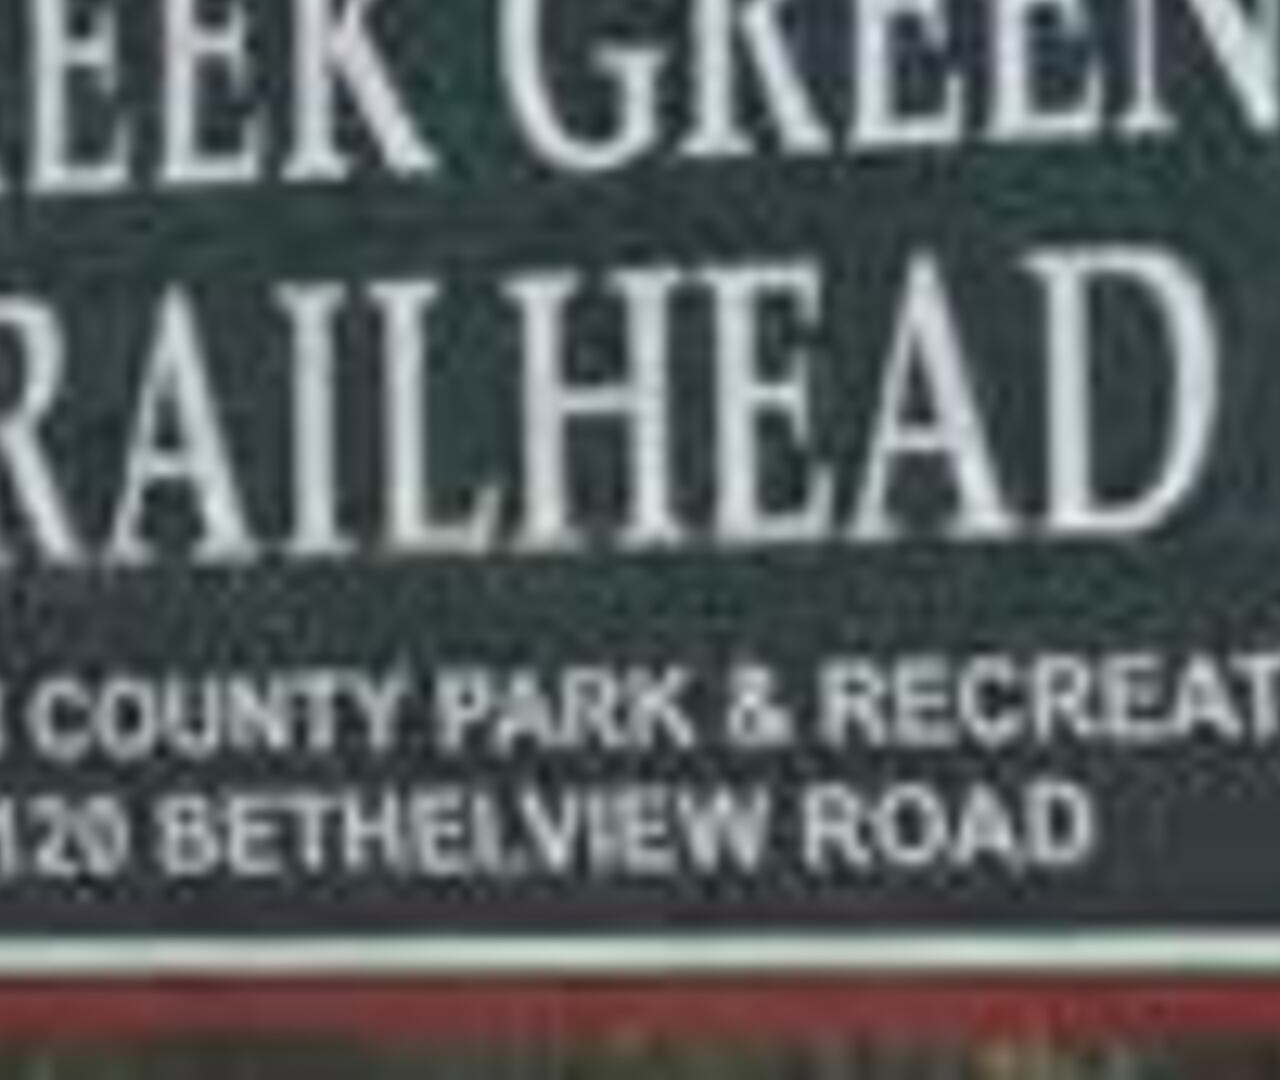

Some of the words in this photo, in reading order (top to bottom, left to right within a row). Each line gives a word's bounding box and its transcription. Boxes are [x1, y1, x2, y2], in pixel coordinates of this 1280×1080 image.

[26, 670, 408, 758] COUNTY
[433, 662, 696, 752] PARK
[724, 664, 796, 748] &
[153, 782, 772, 878] BETHELVIEW
[800, 778, 1097, 870] ROAD
